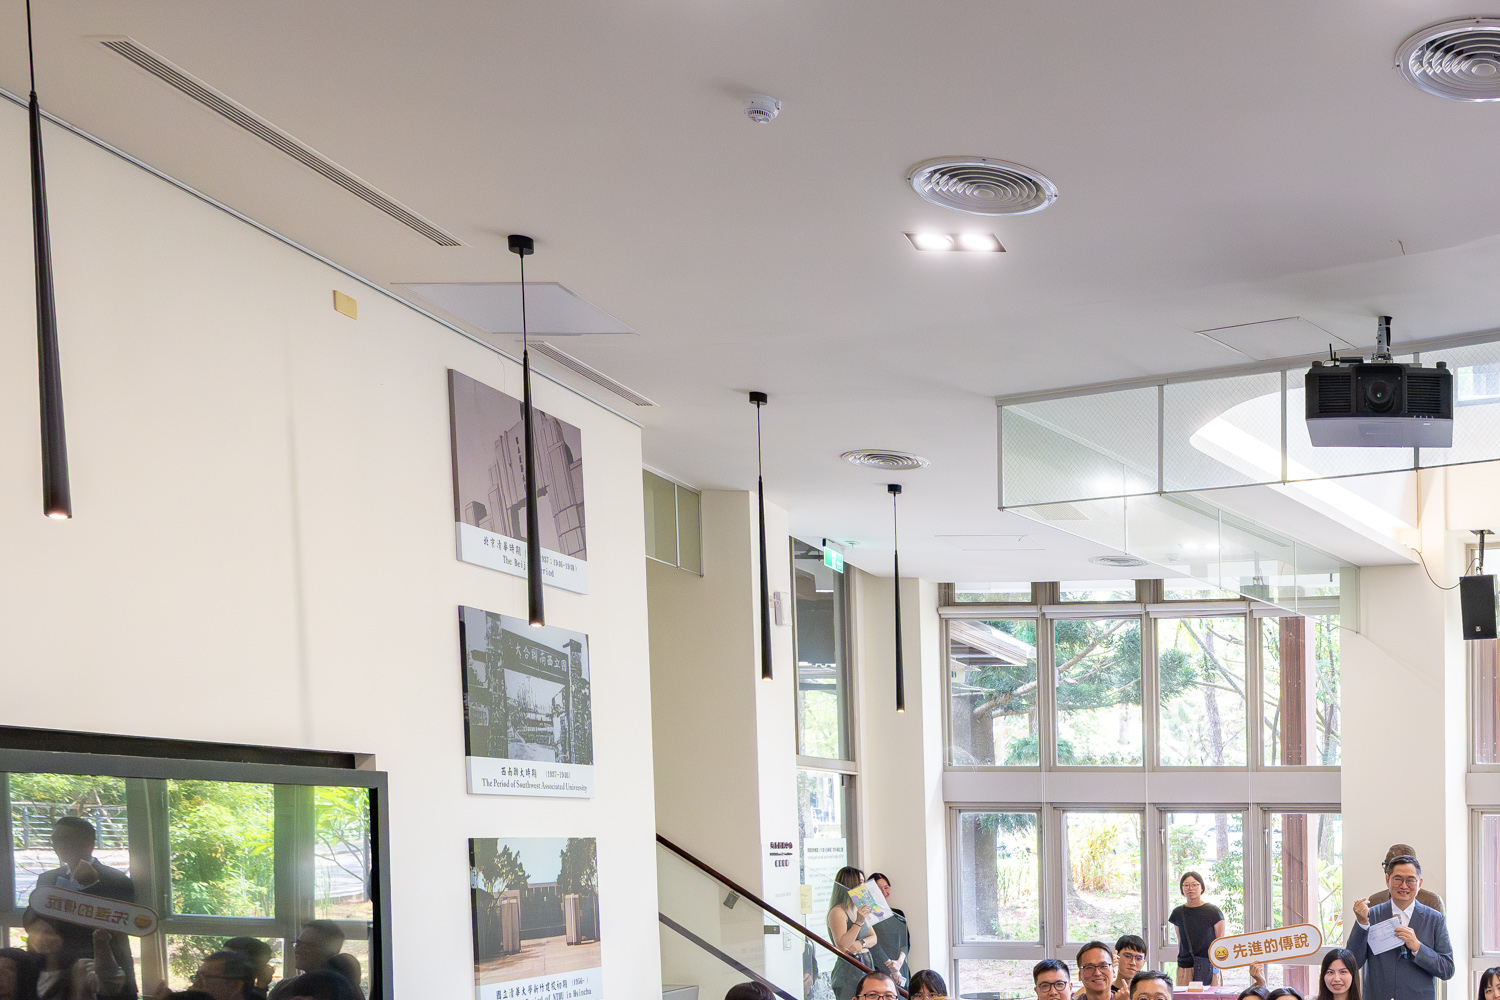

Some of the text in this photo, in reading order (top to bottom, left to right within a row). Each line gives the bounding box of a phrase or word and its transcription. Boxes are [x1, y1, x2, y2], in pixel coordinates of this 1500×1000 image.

[502, 555, 513, 565] The
[501, 766, 537, 779] 西南聯大時期
[482, 778, 588, 793] The Period of Southwest Associated University
[1232, 933, 1310, 959] 先進的傳說
[566, 991, 572, 999] in
[573, 989, 592, 999] Hsinchu
